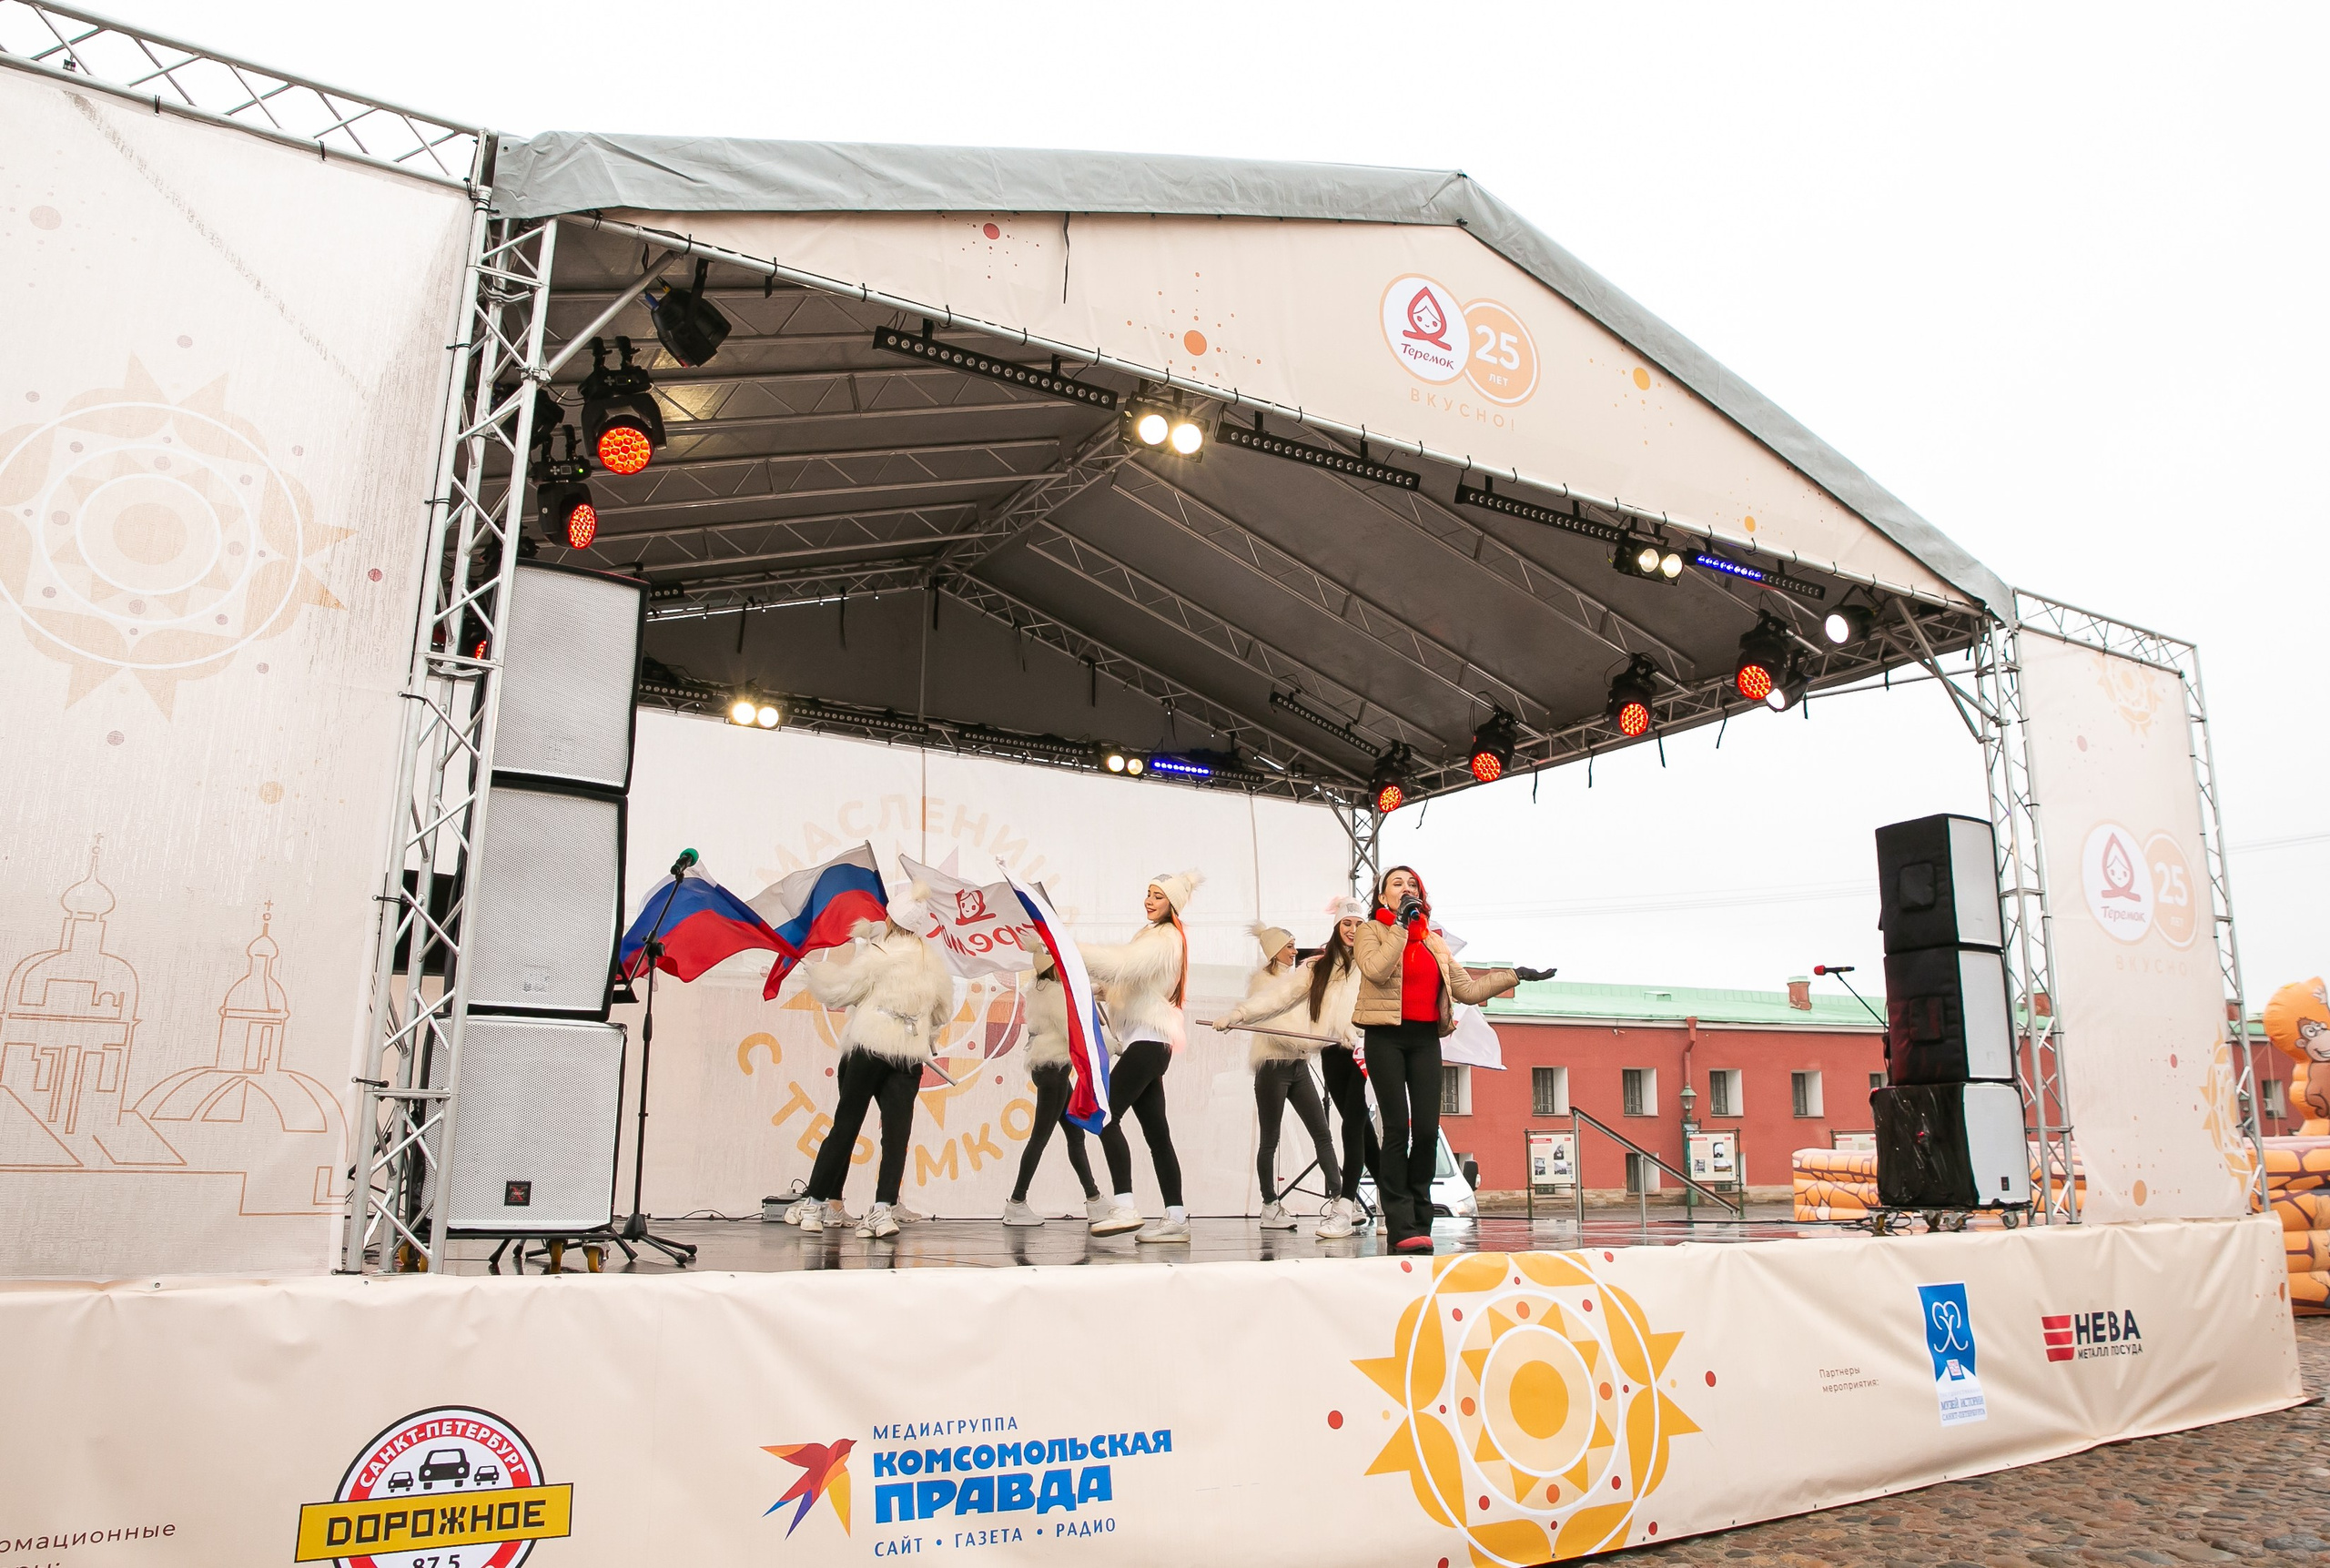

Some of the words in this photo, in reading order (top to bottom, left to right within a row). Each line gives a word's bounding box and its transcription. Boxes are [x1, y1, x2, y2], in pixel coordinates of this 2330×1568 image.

[1401, 342, 1454, 370] Теремок
[1474, 325, 1521, 370] 25
[1488, 373, 1509, 387] ЛЕТ
[1410, 387, 1515, 430] ВКУСНО!
[755, 794, 1080, 924] МАСЛЕНИЦ
[2153, 861, 2188, 906] 25
[737, 1032, 783, 1076] С
[771, 1067, 1079, 1187] ТЕМКО
[2074, 1309, 2142, 1345] НЕВА
[1819, 1368, 1860, 1379] Партнеры
[2078, 1347, 2109, 1360] МЕТАЛЛ
[1822, 1379, 1879, 1393] мероприятия:
[873, 1416, 1018, 1442] МЕДИАГРУППА
[360, 1421, 525, 1488] САНКТ-ПЕТЕРБУРГ
[874, 1430, 1172, 1477] КОМСОМОЛЬСКАЯ
[875, 1464, 1112, 1524] ПРАВДА
[875, 1535, 923, 1557] САЙТ
[955, 1527, 1023, 1549] ГАЗЕТА
[1056, 1518, 1116, 1538] РАДИО
